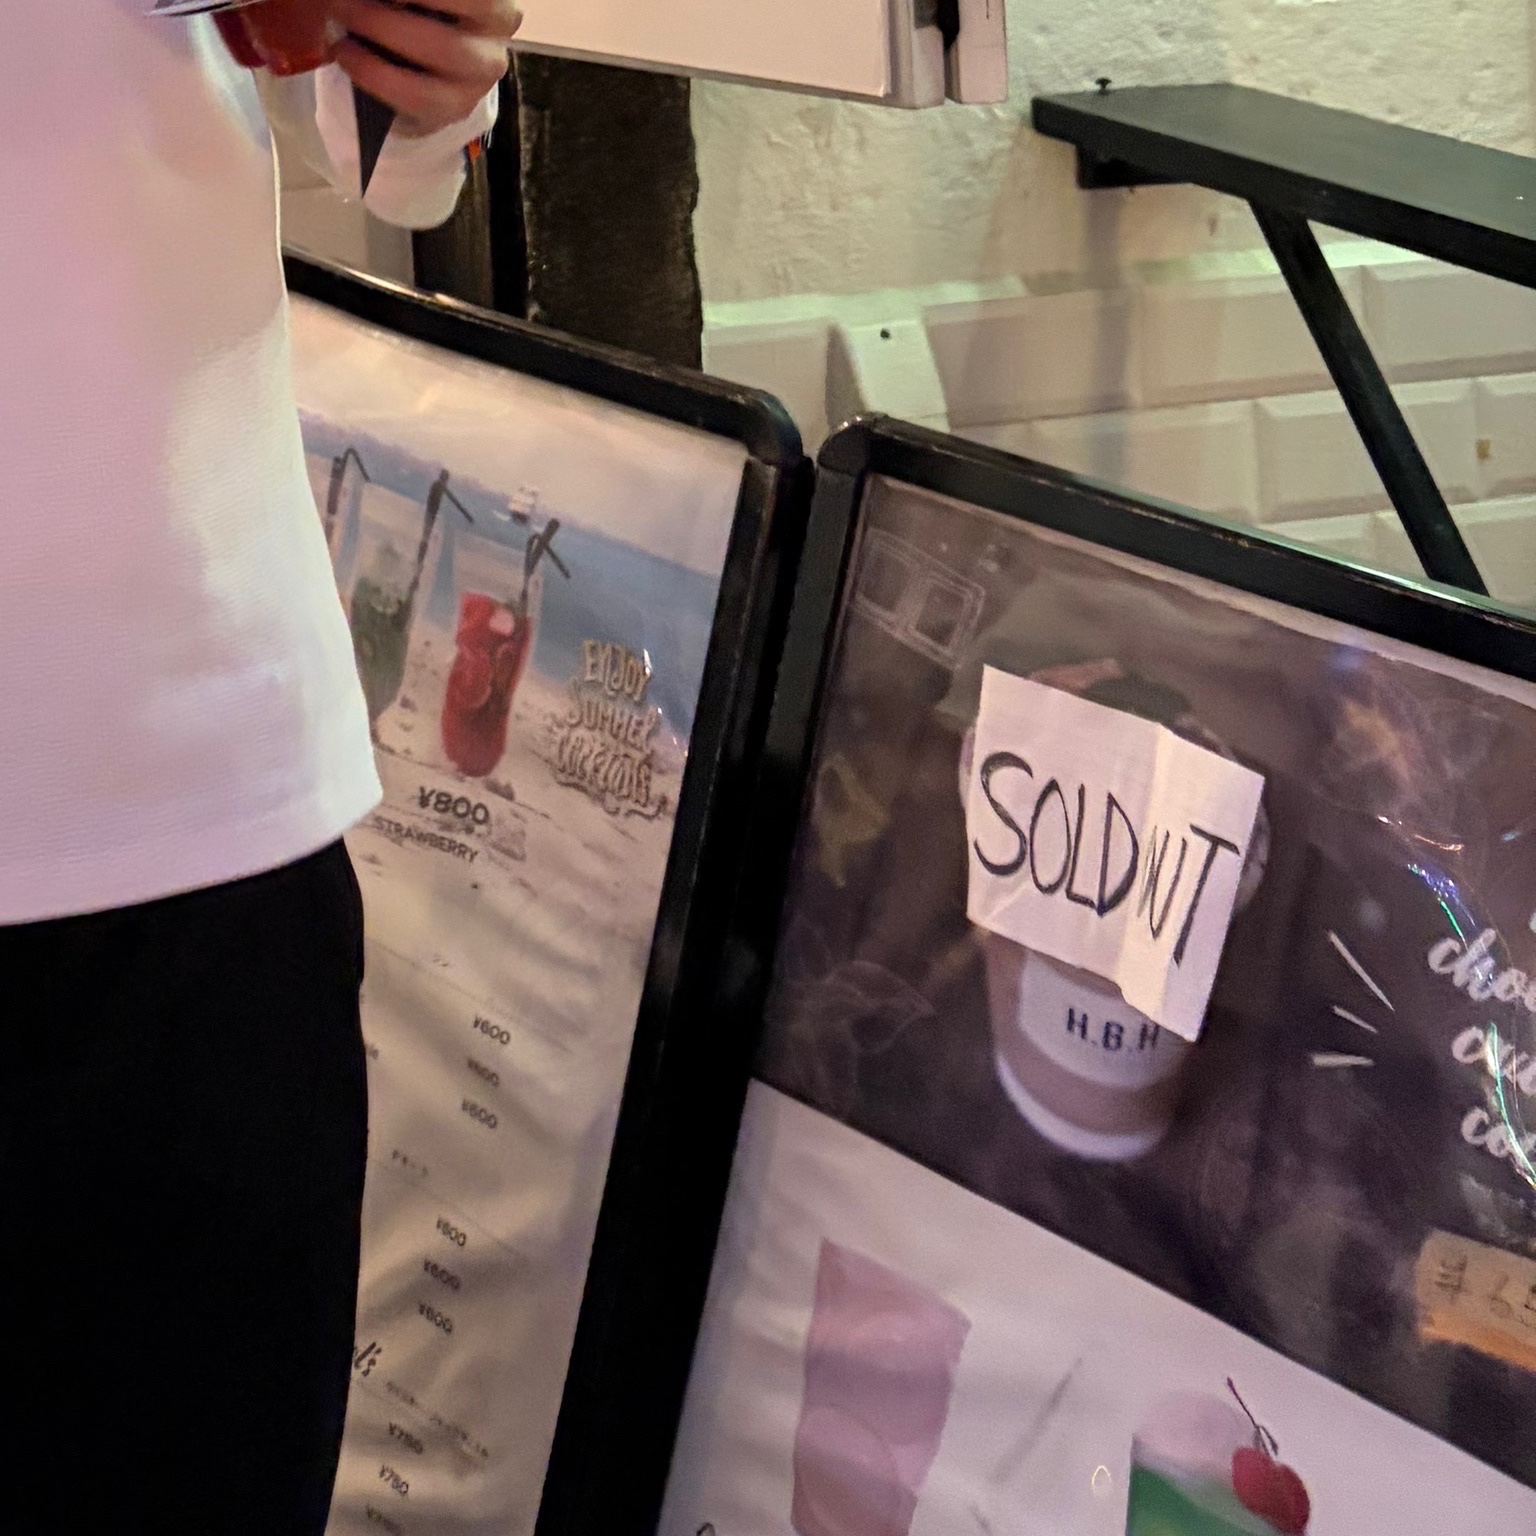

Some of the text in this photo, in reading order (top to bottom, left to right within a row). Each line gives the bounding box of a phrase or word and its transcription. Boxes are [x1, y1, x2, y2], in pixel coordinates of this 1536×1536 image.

[418, 786, 490, 825] ¥800
[372, 815, 479, 863] STRAWBERRY
[473, 1015, 511, 1045] ¥600
[461, 1098, 498, 1130] ¥600
